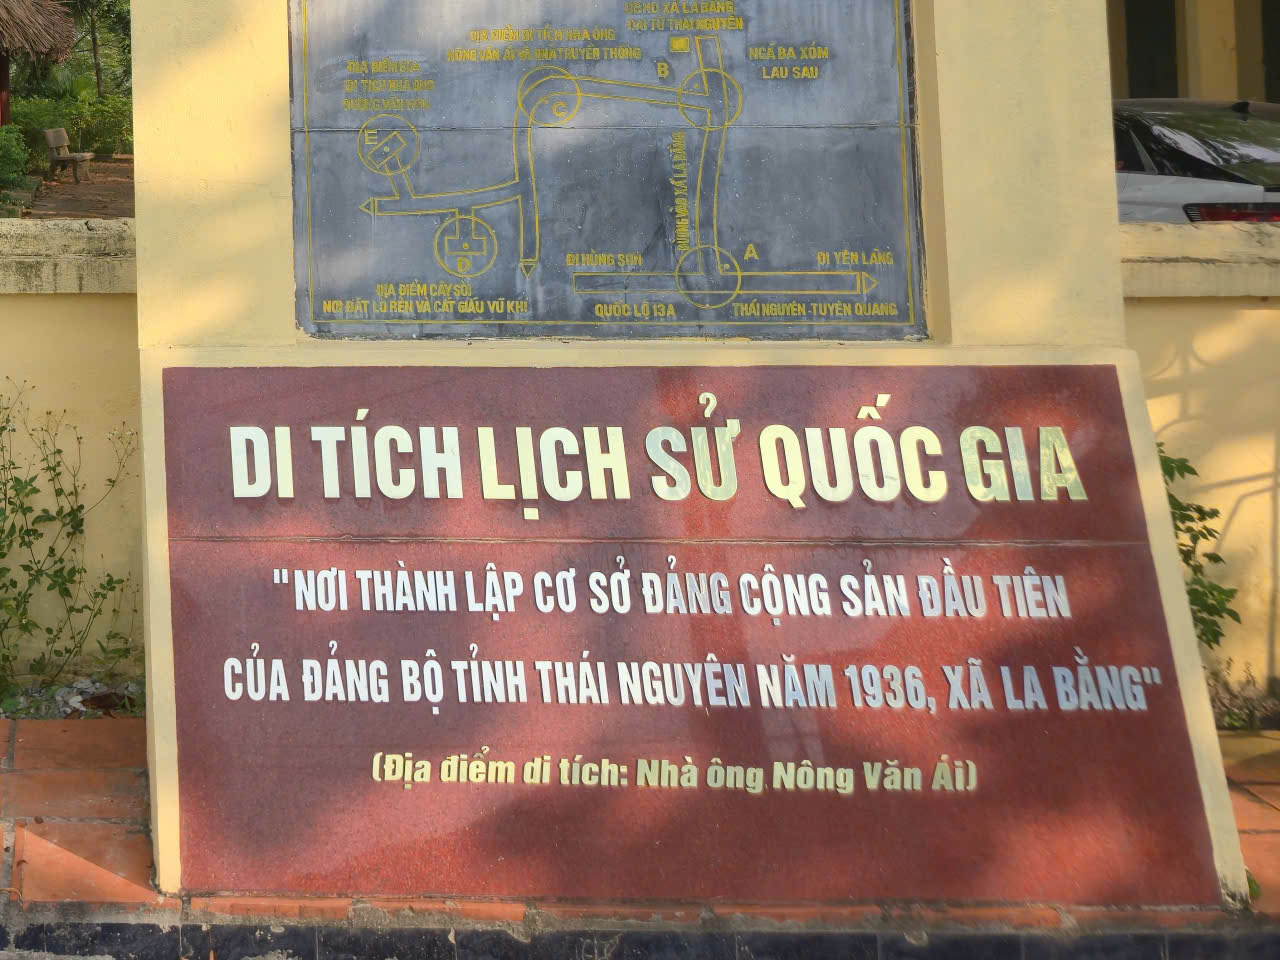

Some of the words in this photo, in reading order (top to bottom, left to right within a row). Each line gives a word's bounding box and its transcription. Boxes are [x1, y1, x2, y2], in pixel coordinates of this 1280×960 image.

[684, 0, 700, 14] LA
[777, 47, 797, 60] BA
[800, 42, 829, 60] XÓM
[657, 63, 669, 78] B
[552, 102, 567, 117] C
[365, 129, 378, 144] E
[566, 253, 579, 265] ĐI
[744, 243, 759, 260] A
[817, 251, 830, 265] ĐI
[834, 249, 859, 265] YÊN
[457, 257, 471, 272] D
[416, 297, 431, 313] VÀ
[732, 298, 761, 316] THÁI
[854, 303, 898, 316] QUANG
[229, 426, 294, 498] DI
[311, 408, 464, 499] TÍCH
[477, 426, 632, 520] LỊCH
[645, 392, 740, 501] SỬ
[758, 393, 948, 509] QUỐC
[959, 425, 1088, 502] GIA
[273, 567, 348, 612] "NƠI
[355, 560, 457, 613] THÀNH
[464, 562, 522, 621] LẬP
[533, 567, 576, 613] CƠ
[589, 555, 630, 614] SỞ
[642, 555, 732, 616] ĐẢNG
[740, 563, 831, 626] CỘNG
[839, 558, 910, 617] SẢN
[918, 557, 985, 618] ĐẦU
[992, 566, 1071, 618] TIÊN
[223, 642, 290, 702] CỦA
[302, 640, 389, 703] ĐẢNG
[401, 648, 444, 715] BỘ
[451, 642, 528, 703] TỈNH
[534, 651, 609, 704] THÁI
[617, 653, 751, 707] NGUYÊN
[756, 653, 837, 708] NĂM
[843, 663, 937, 714] 1936,
[940, 658, 993, 711] XÃ
[1000, 667, 1048, 711] LA
[1051, 646, 1163, 712] BẰNG"
[371, 753, 431, 789] (Địa
[440, 746, 515, 784] điểm
[523, 756, 551, 783] di
[559, 754, 628, 786] tích:
[635, 755, 698, 787] Nhà
[706, 755, 764, 793] ông
[771, 758, 855, 793] Nông
[862, 760, 922, 790] Văn
[931, 754, 978, 791] Ái)
